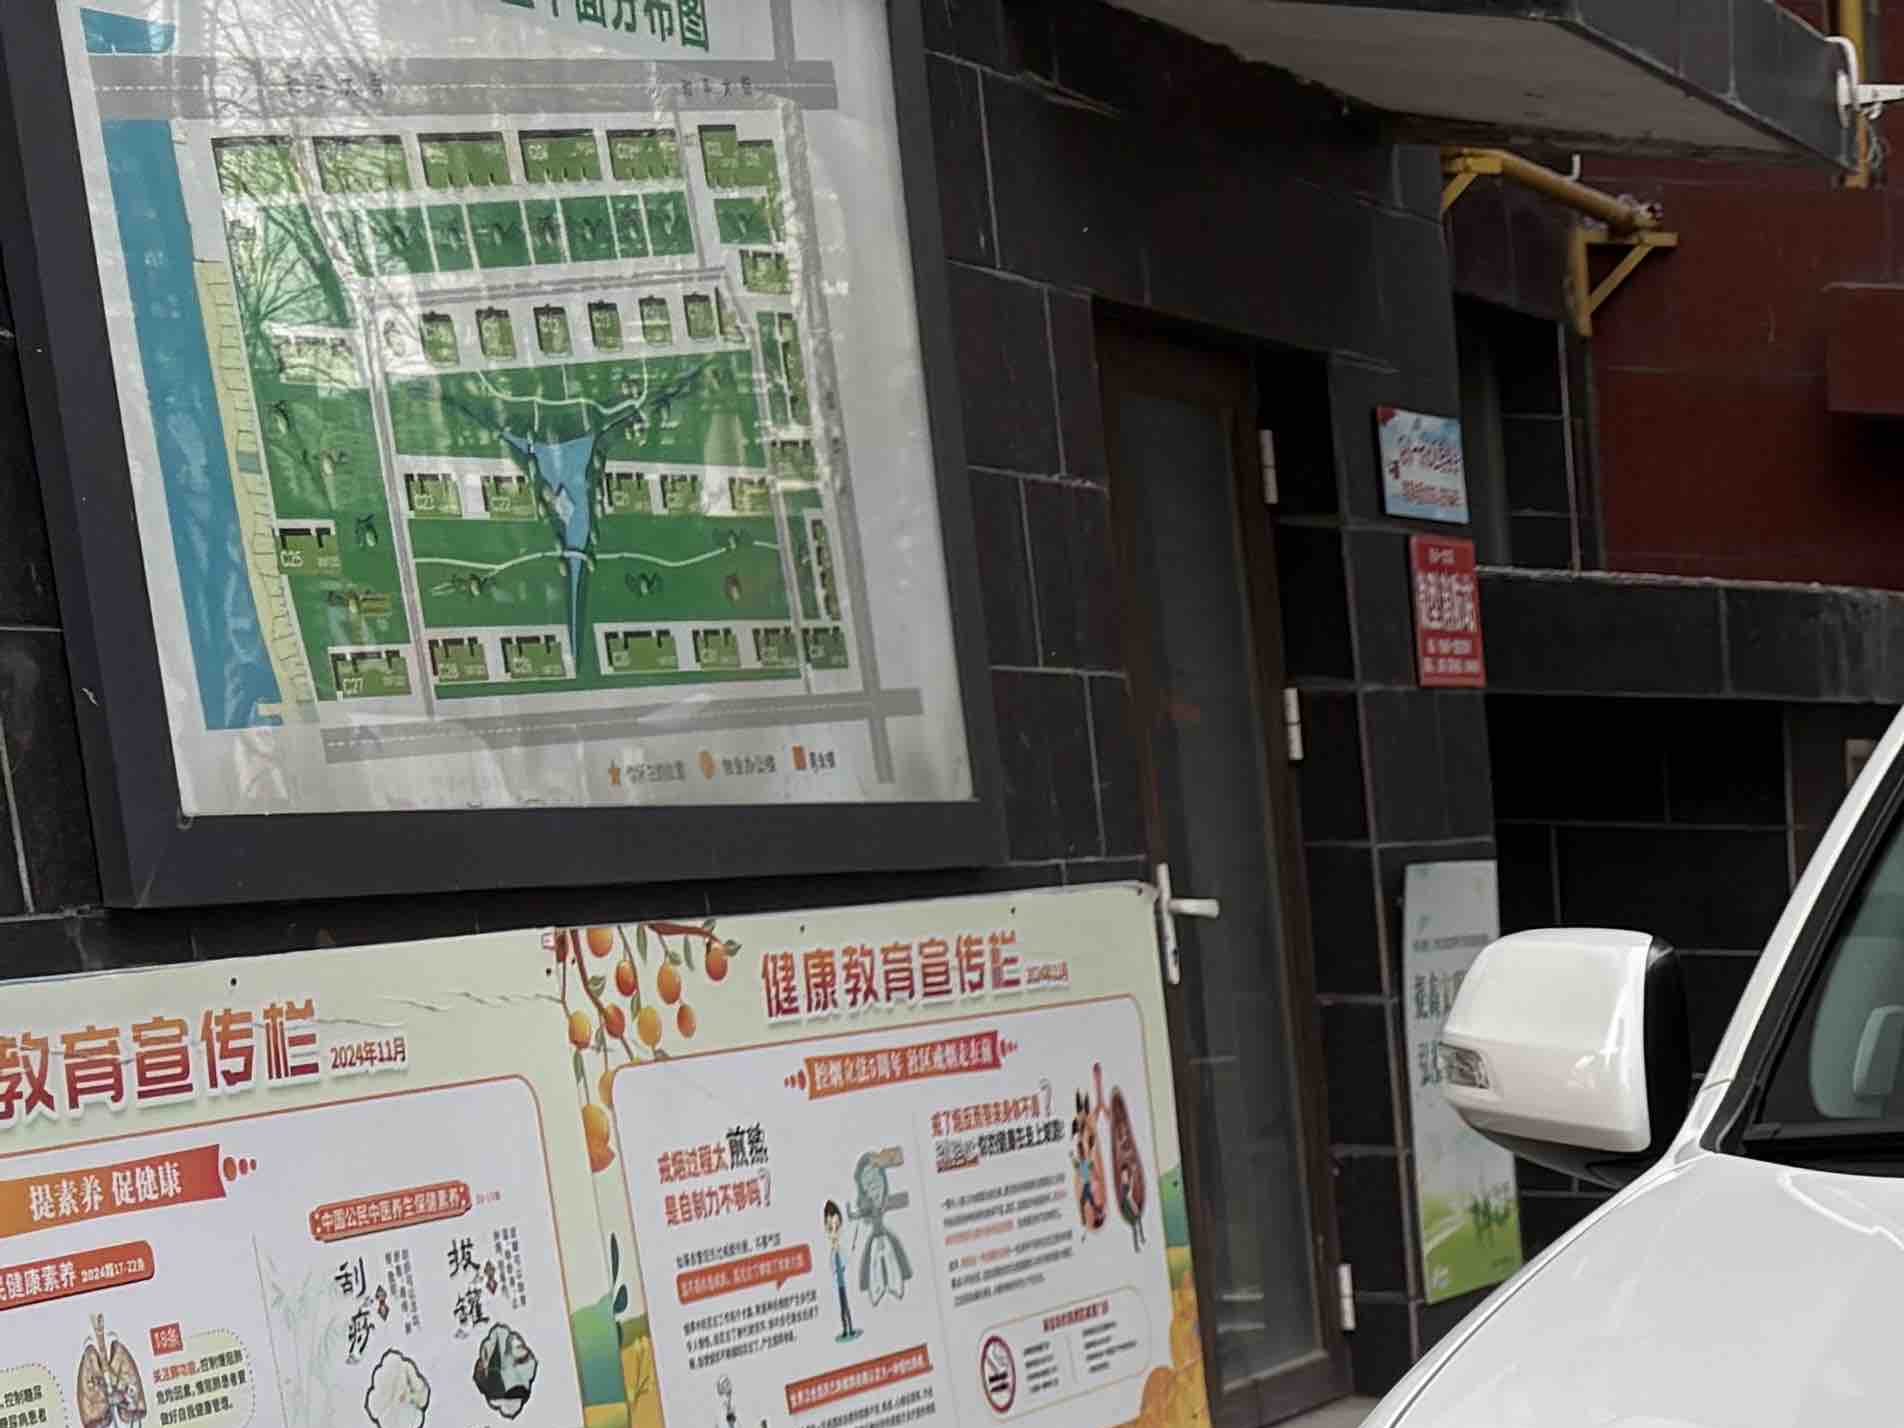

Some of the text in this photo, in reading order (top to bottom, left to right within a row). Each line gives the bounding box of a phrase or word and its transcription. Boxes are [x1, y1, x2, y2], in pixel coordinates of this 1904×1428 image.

[762, 929, 1021, 1018] 健康教育宣传栏
[0, 998, 406, 1117] 教育宣传栏 2024年11月
[28, 1162, 182, 1221] 提素养 促健康
[658, 1122, 768, 1184] 戒烟过程太煎熬
[322, 1189, 459, 1233] 中国公民中医养生保健素养
[334, 1256, 375, 1355] 刮痧
[447, 1237, 490, 1326] 拔罐
